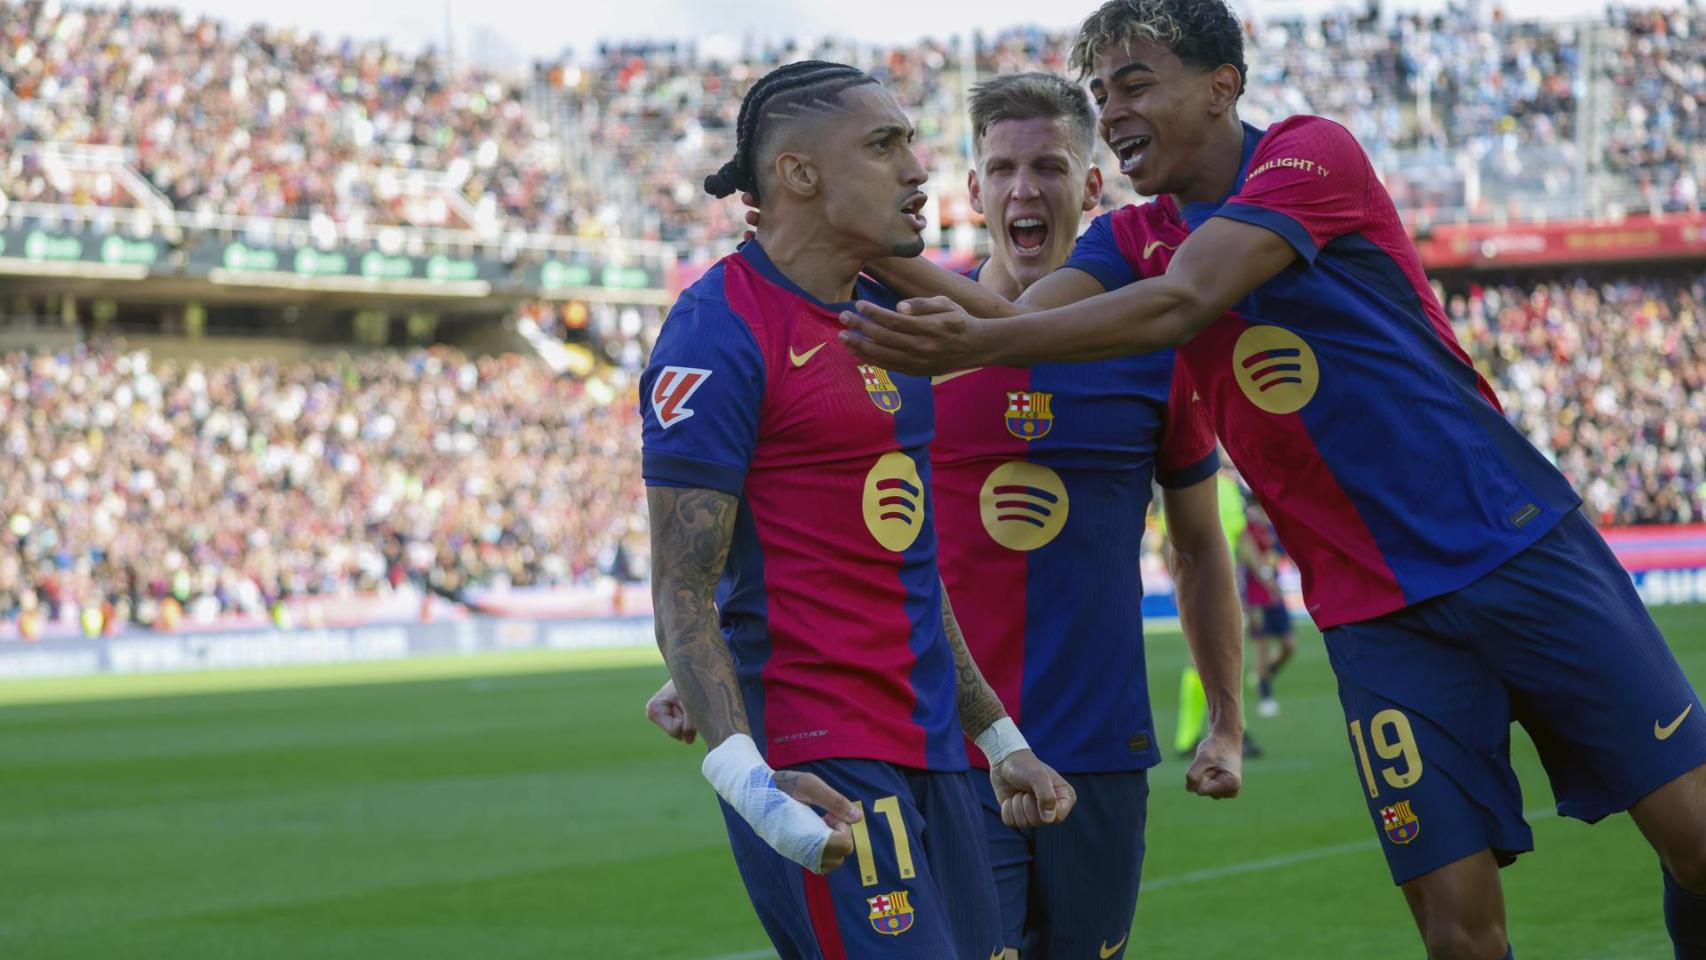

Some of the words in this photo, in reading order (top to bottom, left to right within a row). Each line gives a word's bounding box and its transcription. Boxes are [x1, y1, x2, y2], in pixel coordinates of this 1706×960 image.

[1245, 158, 1315, 182] MBILIGHT
[1317, 165, 1330, 177] tv
[1350, 709, 1423, 798] 19
[850, 795, 916, 887] 11
